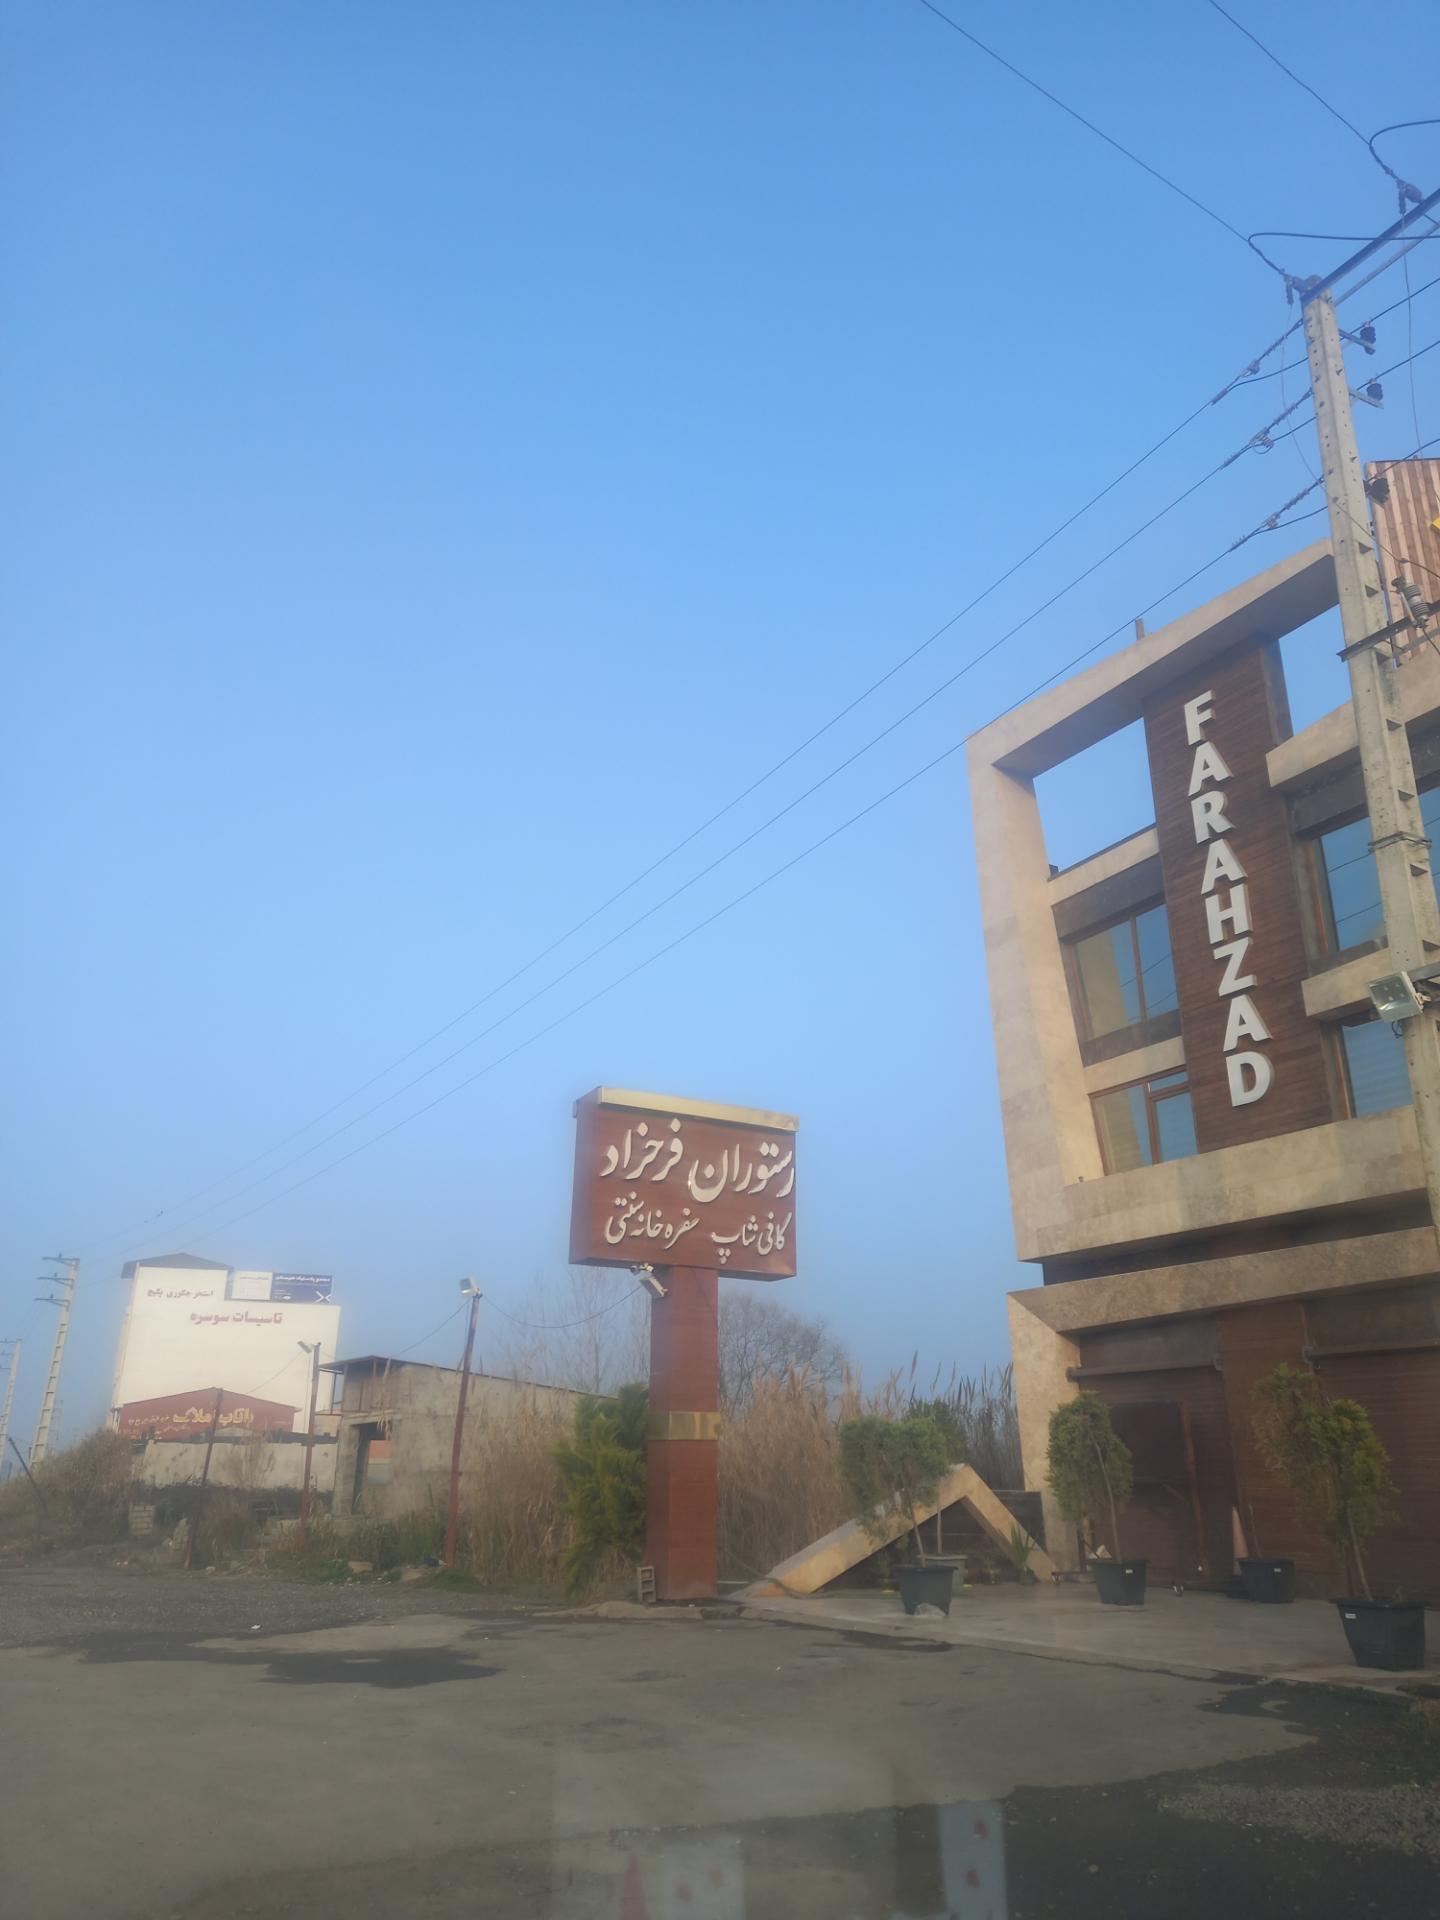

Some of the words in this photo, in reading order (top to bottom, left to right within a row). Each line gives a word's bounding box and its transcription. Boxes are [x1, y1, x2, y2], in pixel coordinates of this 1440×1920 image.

[1184, 690, 1275, 1107] FARAHZAD
[599, 1118, 684, 1181] فرخزاد
[688, 1142, 795, 1202] رستوران
[605, 1191, 645, 1244] سنتی
[711, 1214, 758, 1264] شاپ
[757, 1211, 792, 1256] کافی
